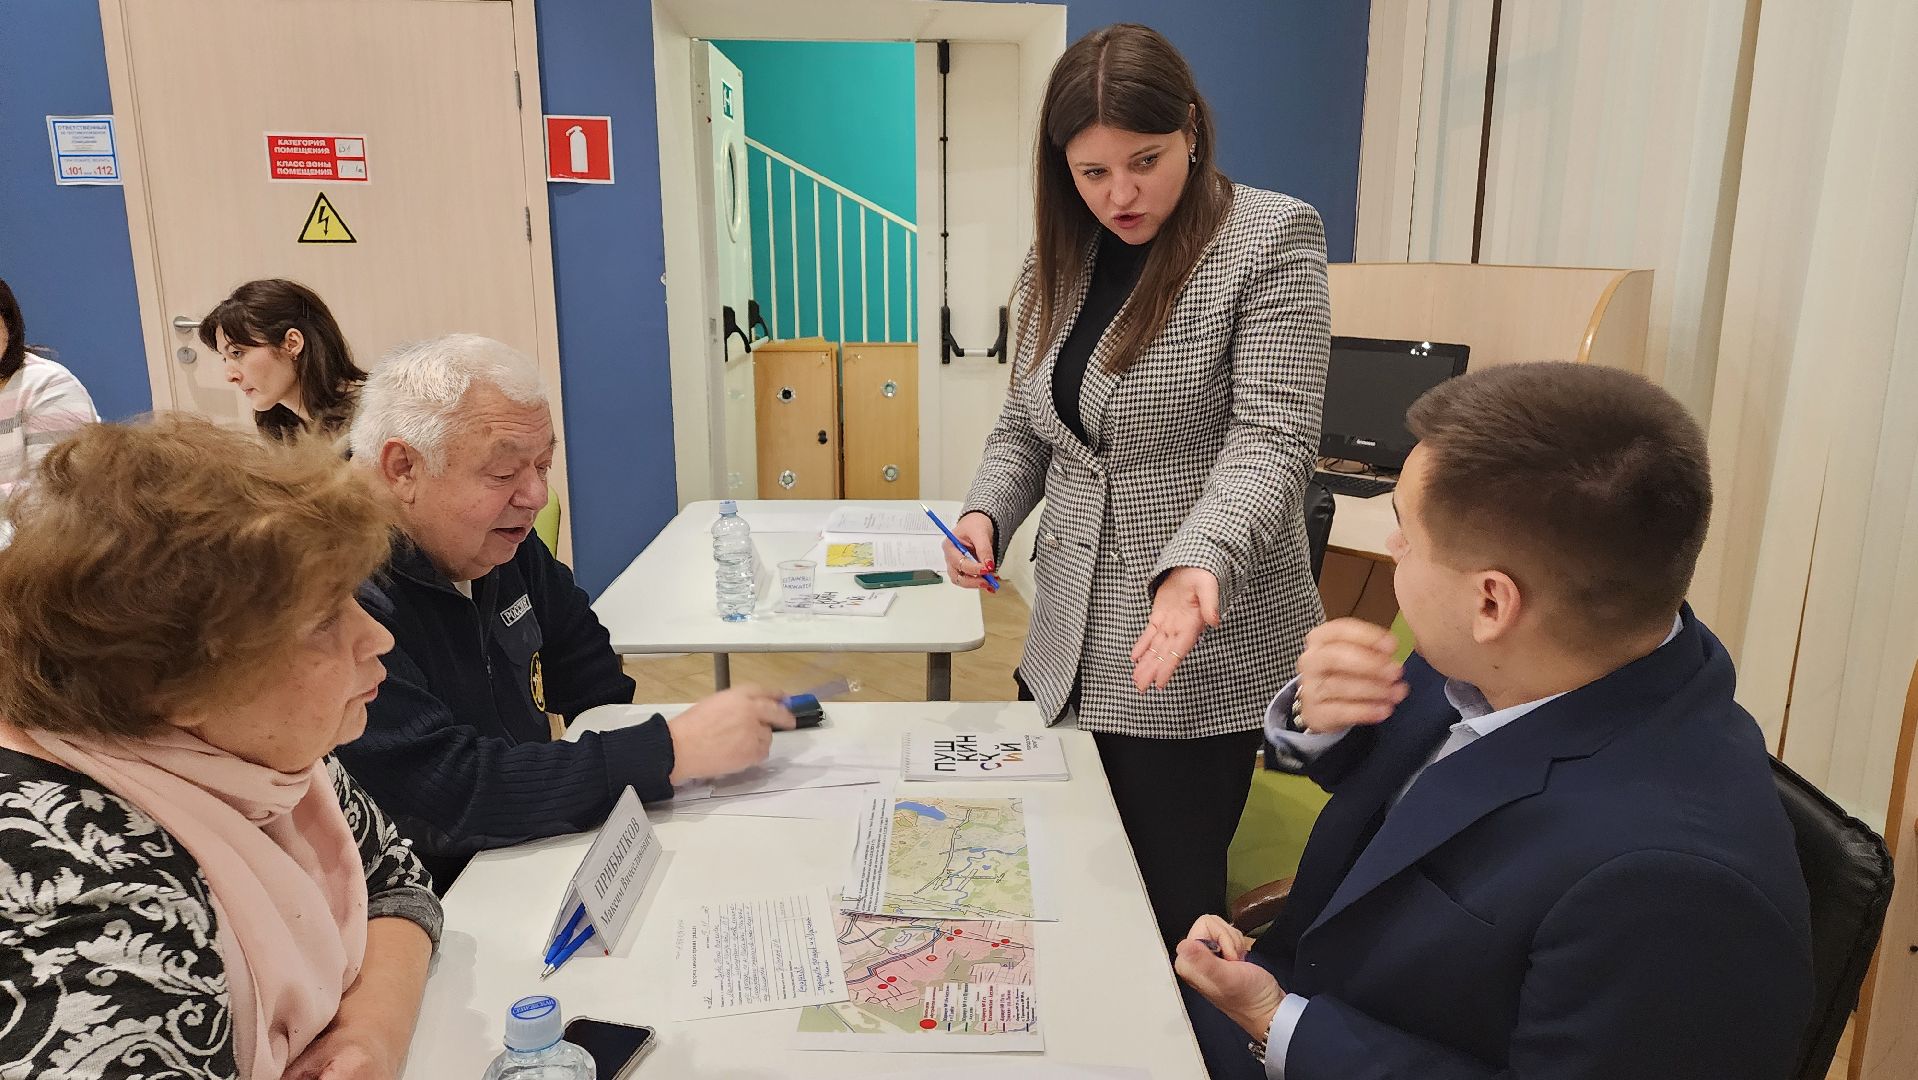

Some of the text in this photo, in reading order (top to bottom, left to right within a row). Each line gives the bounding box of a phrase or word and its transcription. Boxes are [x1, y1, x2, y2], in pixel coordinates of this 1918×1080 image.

[277, 139, 326, 147] КАТЕГОРИЯ
[274, 146, 331, 154] ПОМЕЩЕНИЯ
[276, 160, 332, 168] КЛАСС ЗОНЫ
[97, 166, 113, 175] 112
[277, 168, 333, 176] ПОМЕЩЕНИЯ
[956, 735, 978, 762] КИН
[934, 740, 956, 772] ПУШ
[594, 817, 640, 900] ПРИБЫТКОВ
[600, 888, 624, 928] Максим
